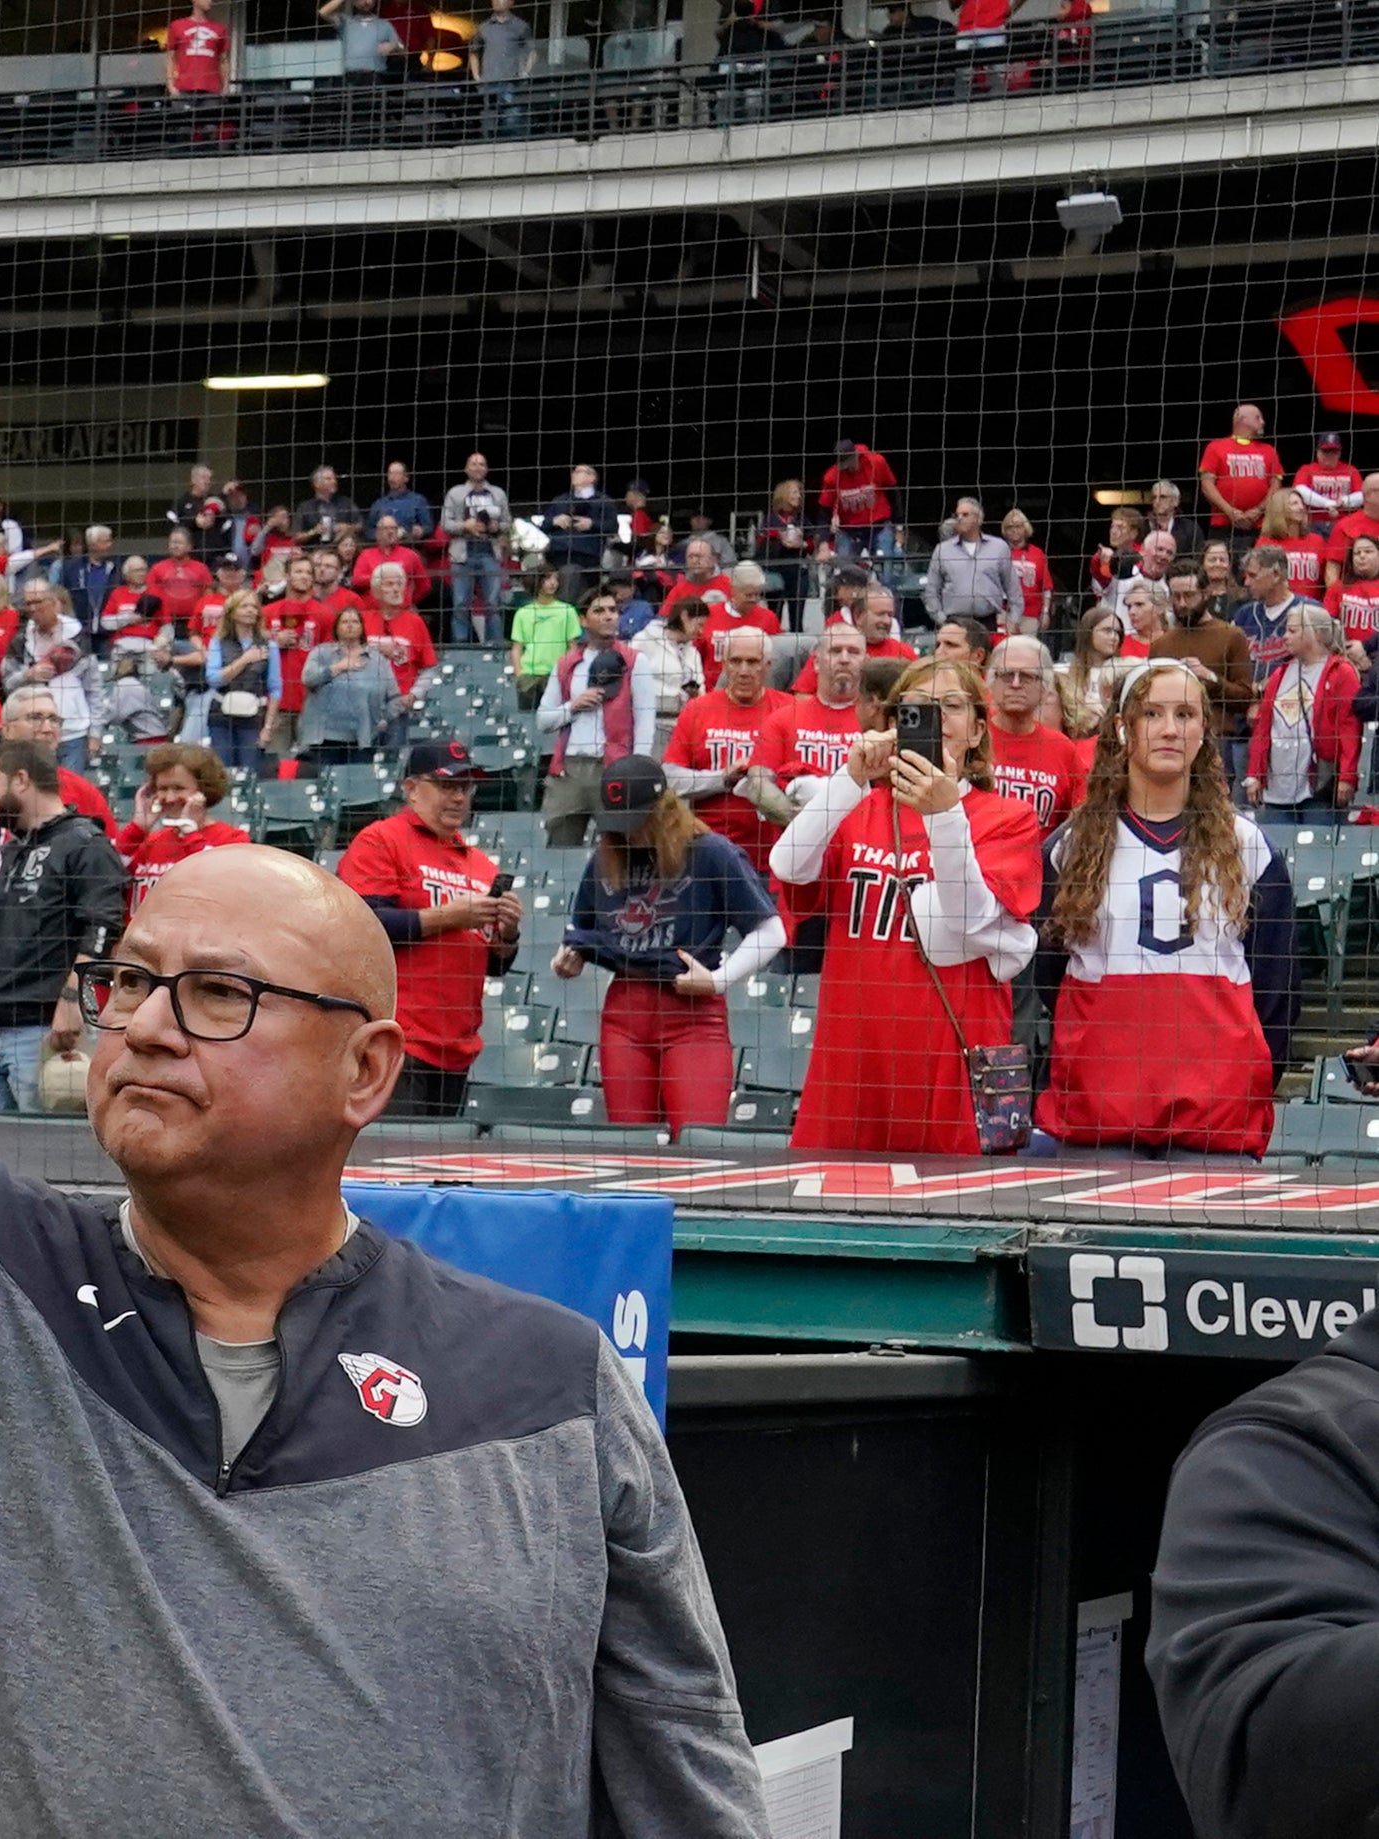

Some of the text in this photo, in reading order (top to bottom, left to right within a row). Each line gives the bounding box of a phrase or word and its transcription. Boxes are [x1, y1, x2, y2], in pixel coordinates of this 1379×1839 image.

[796, 729, 864, 743] THANK YO
[705, 739, 755, 771] TIT
[795, 740, 851, 775] TIT
[991, 764, 1058, 787] ANK YOU
[606, 781, 623, 803] C
[419, 864, 467, 886] THANK
